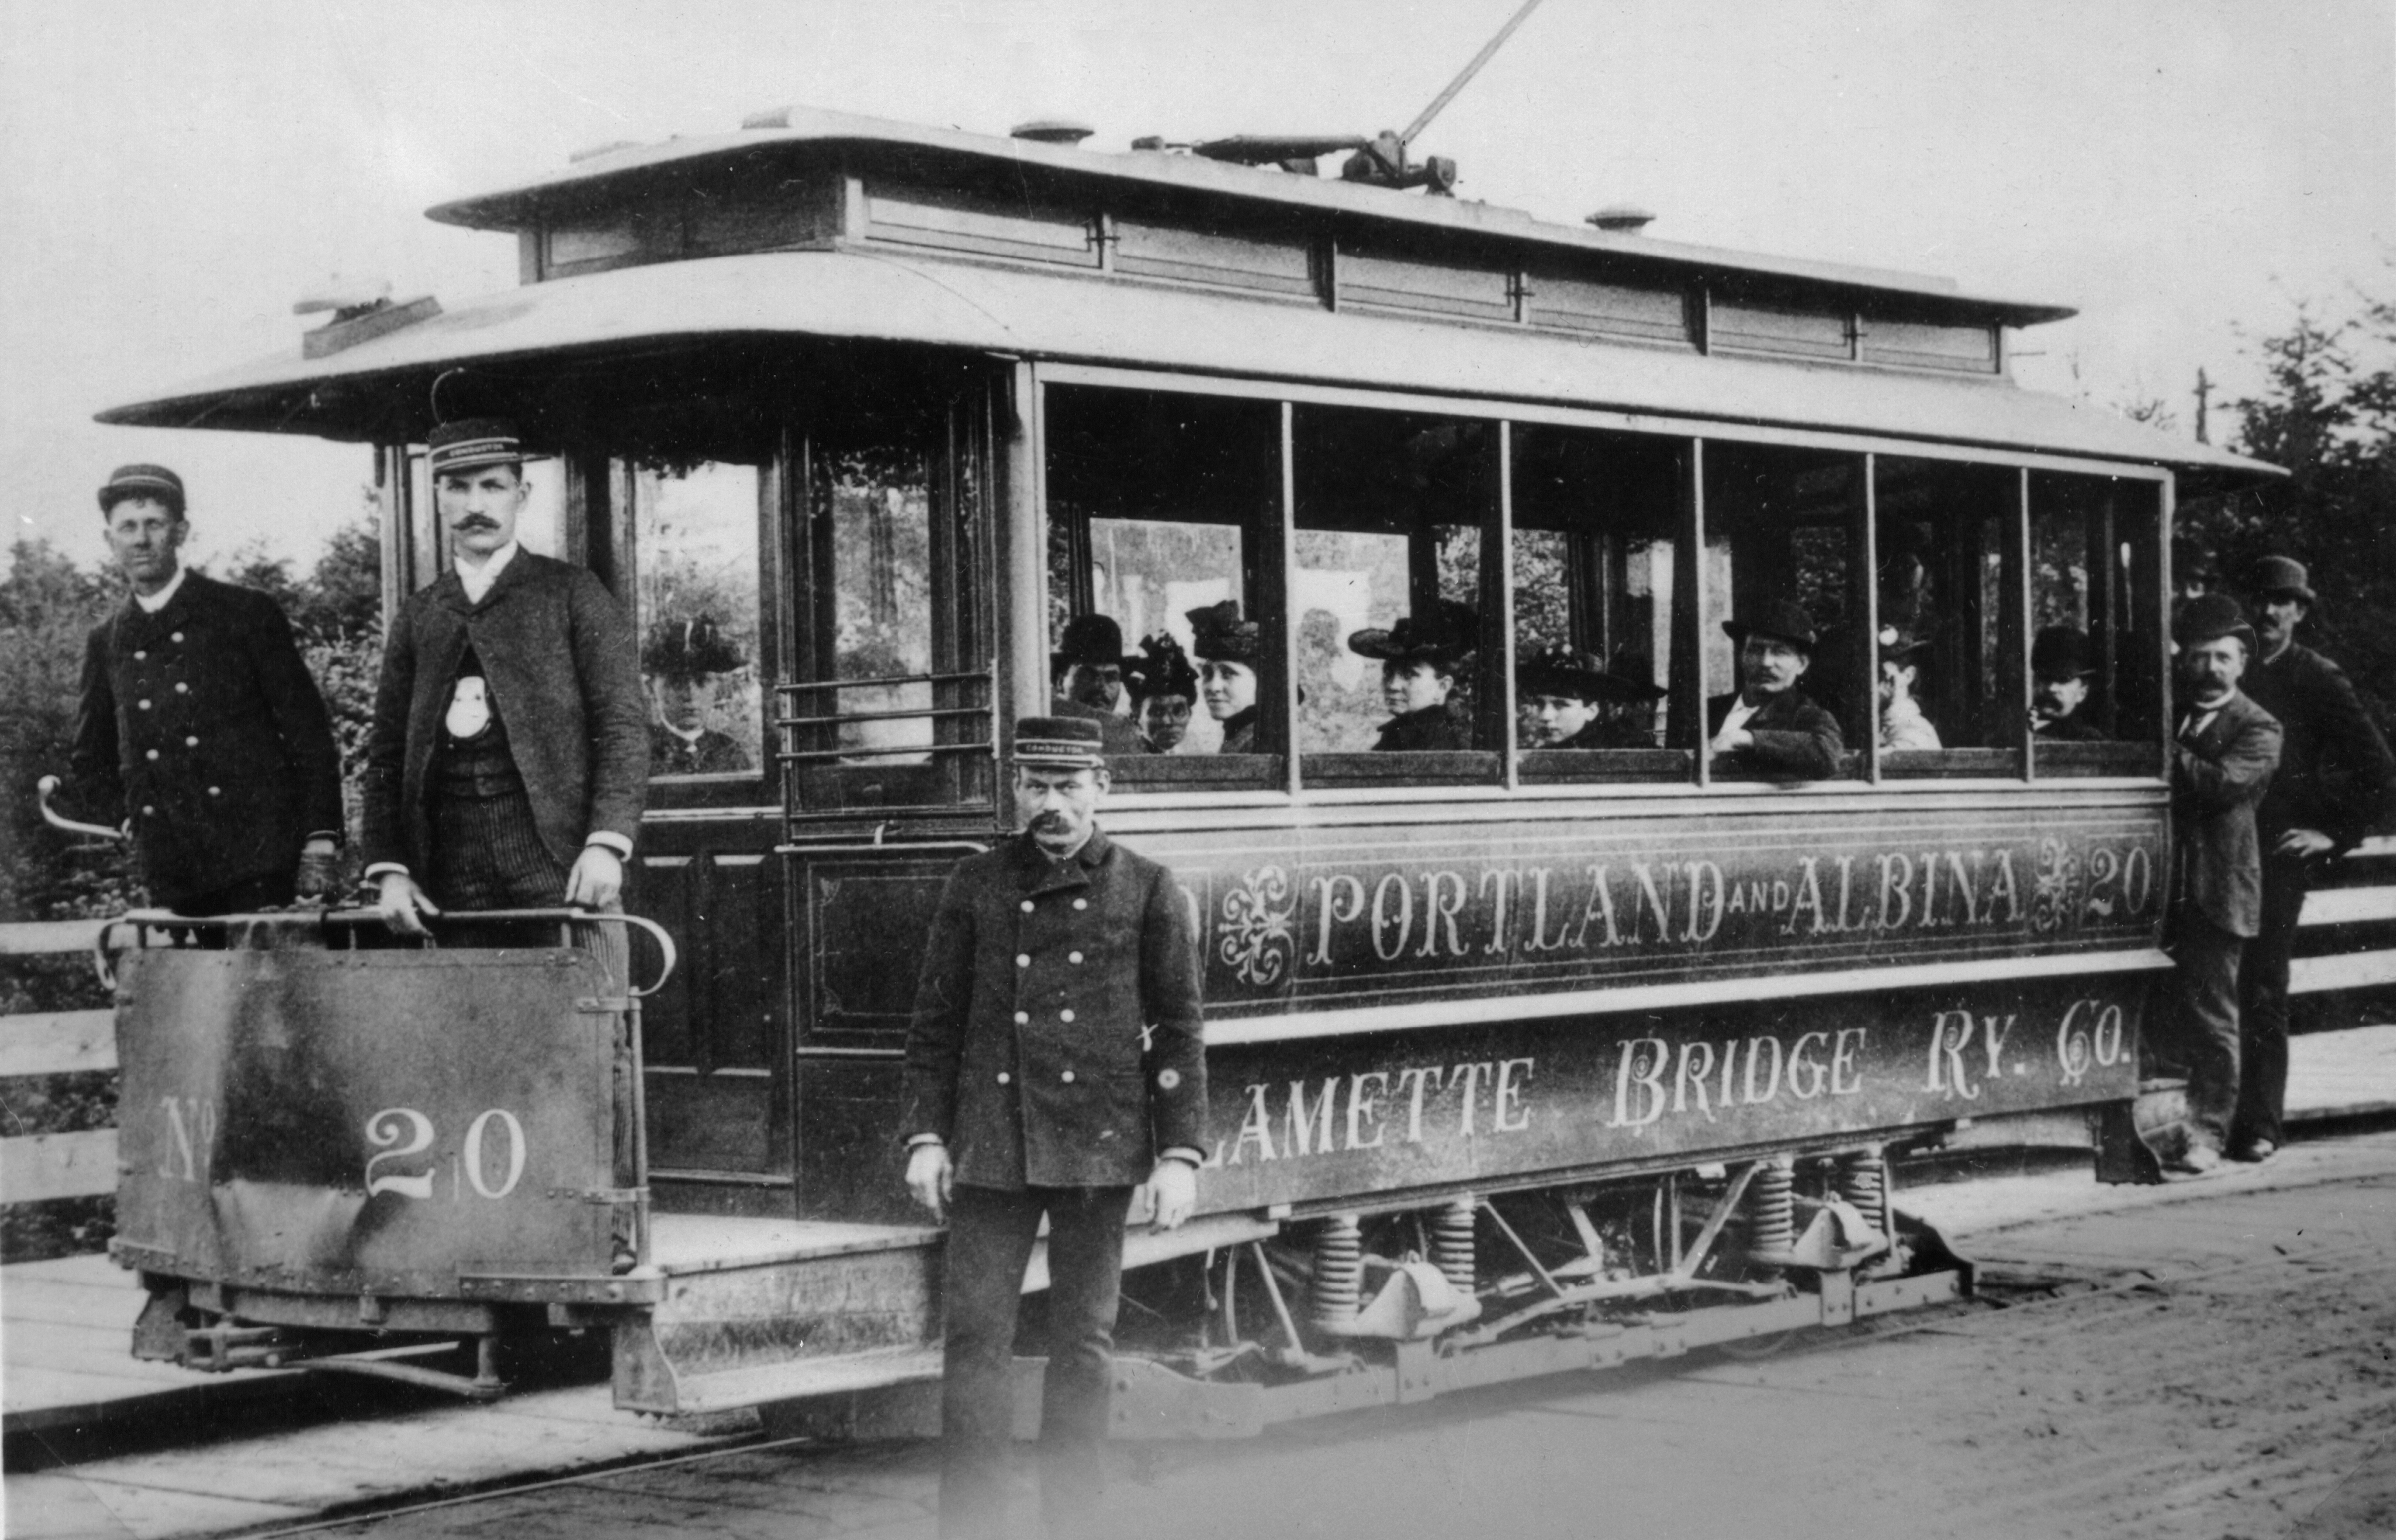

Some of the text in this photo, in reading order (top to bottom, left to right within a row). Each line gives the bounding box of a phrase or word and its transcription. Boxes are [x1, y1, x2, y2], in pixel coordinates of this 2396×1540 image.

[1307, 845, 2151, 966] PORTLAND AND ALBINA 20
[1606, 1027, 1867, 1137] BRIDGE
[1920, 1009, 2026, 1100] RY.
[365, 1107, 526, 1199] 20
